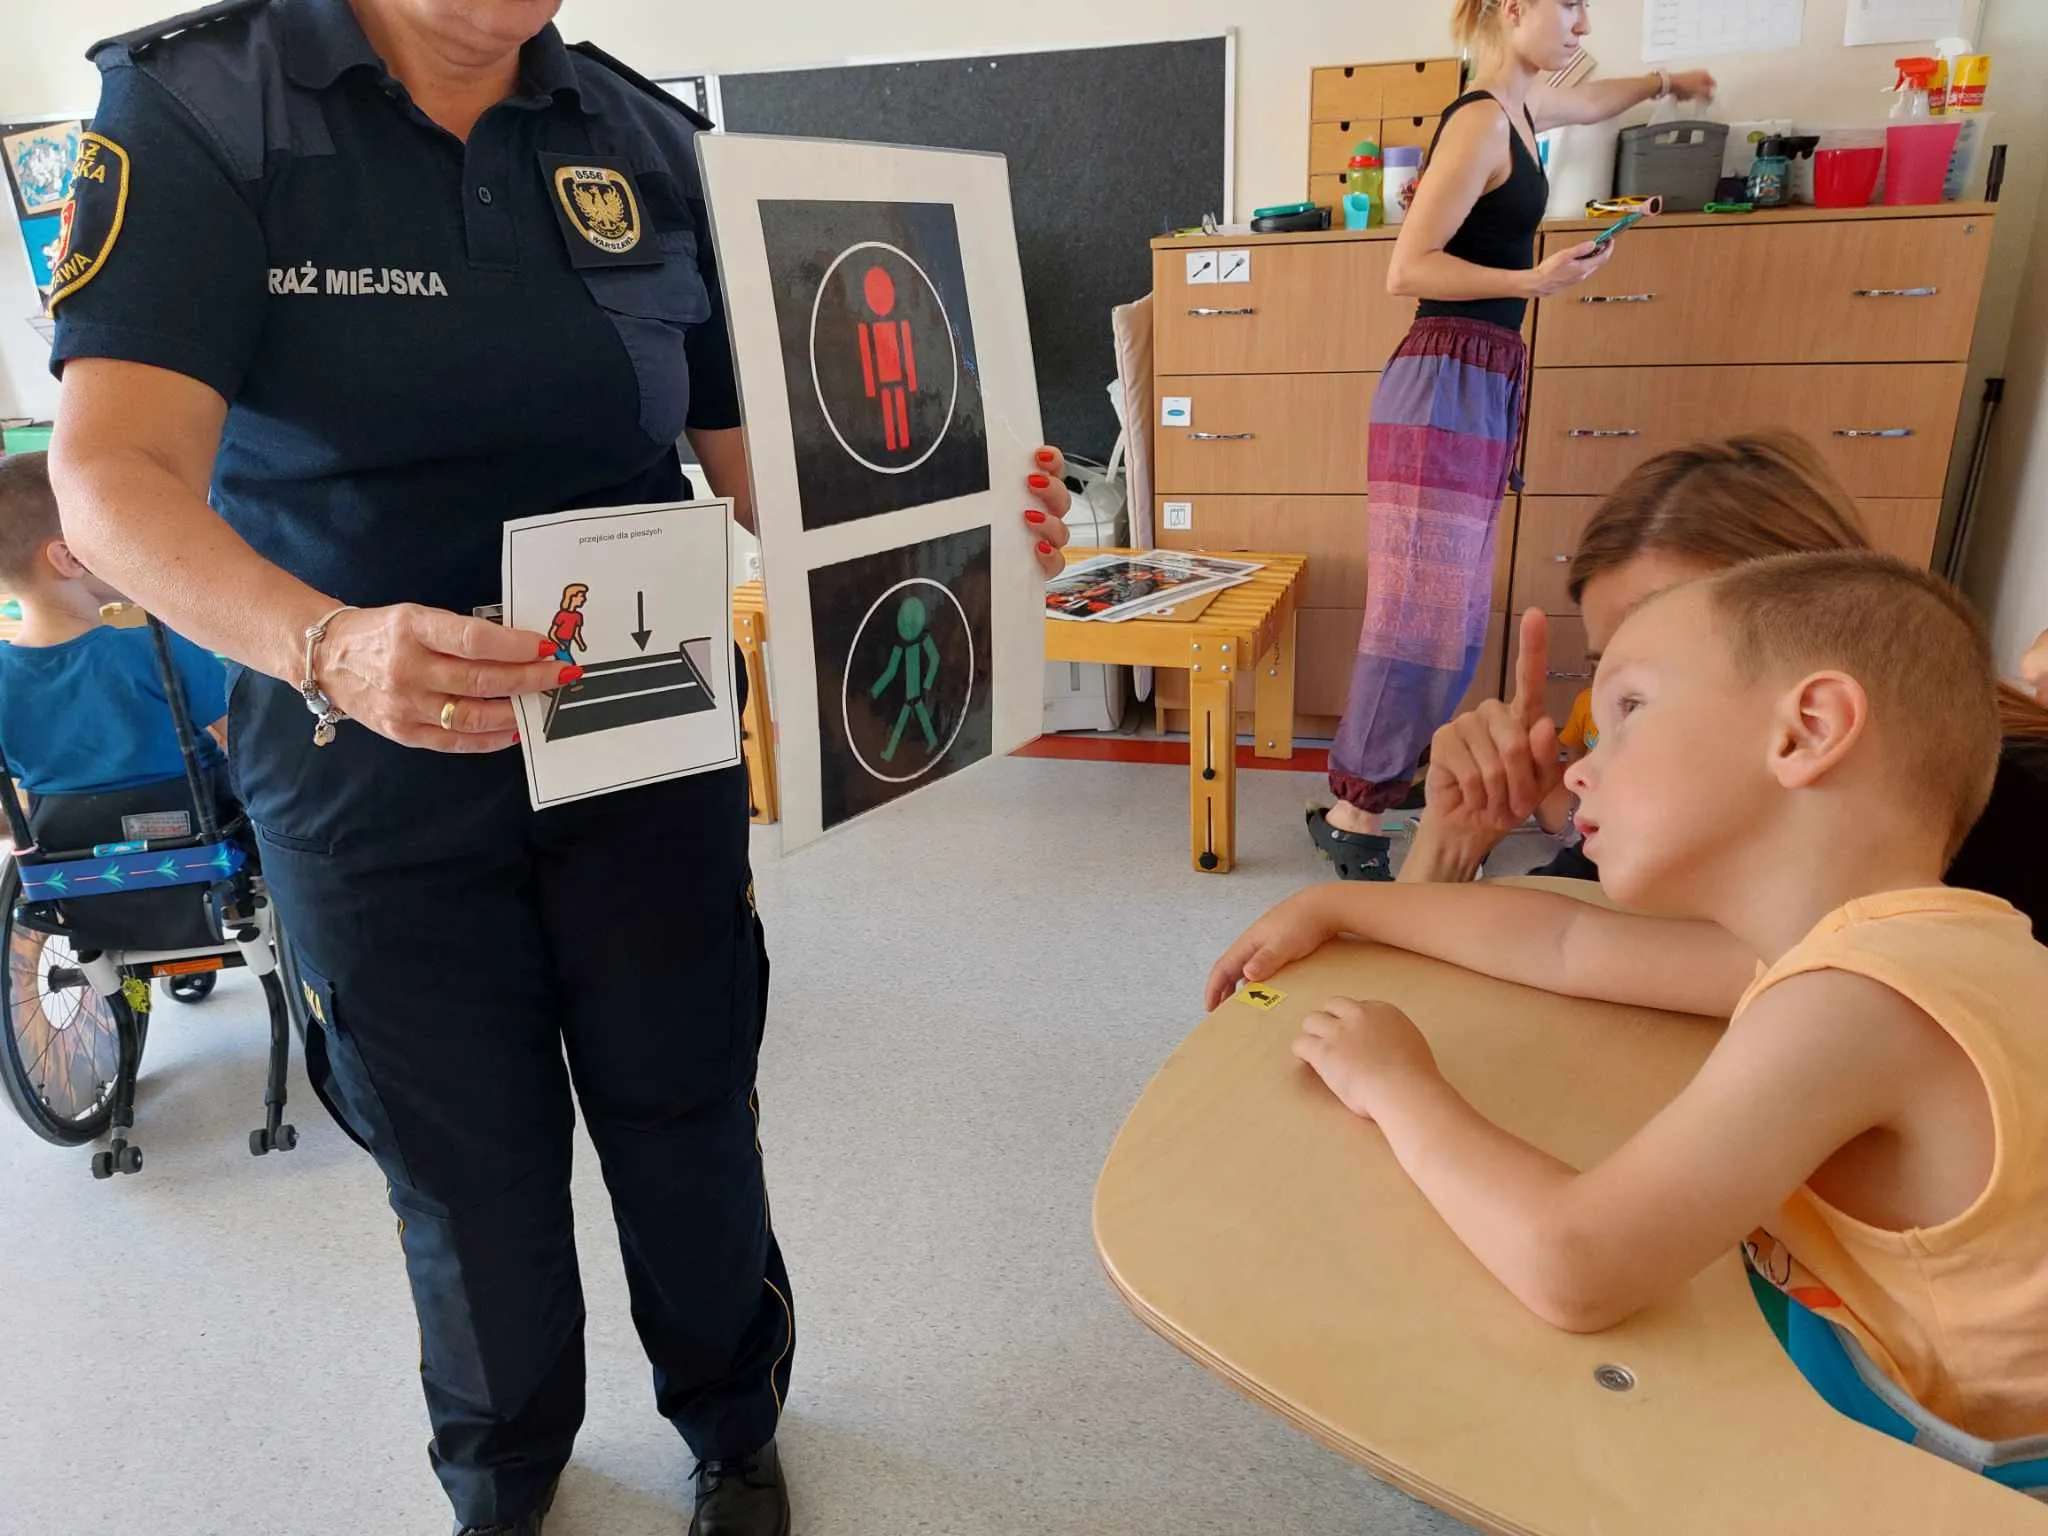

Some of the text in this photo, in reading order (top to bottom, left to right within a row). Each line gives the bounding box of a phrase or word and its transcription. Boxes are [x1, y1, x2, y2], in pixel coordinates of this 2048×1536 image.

[592, 235, 634, 250] WARSZAWA
[325, 267, 449, 297] MIEJSKA
[616, 531, 629, 540] dla
[630, 527, 663, 539] pieszych
